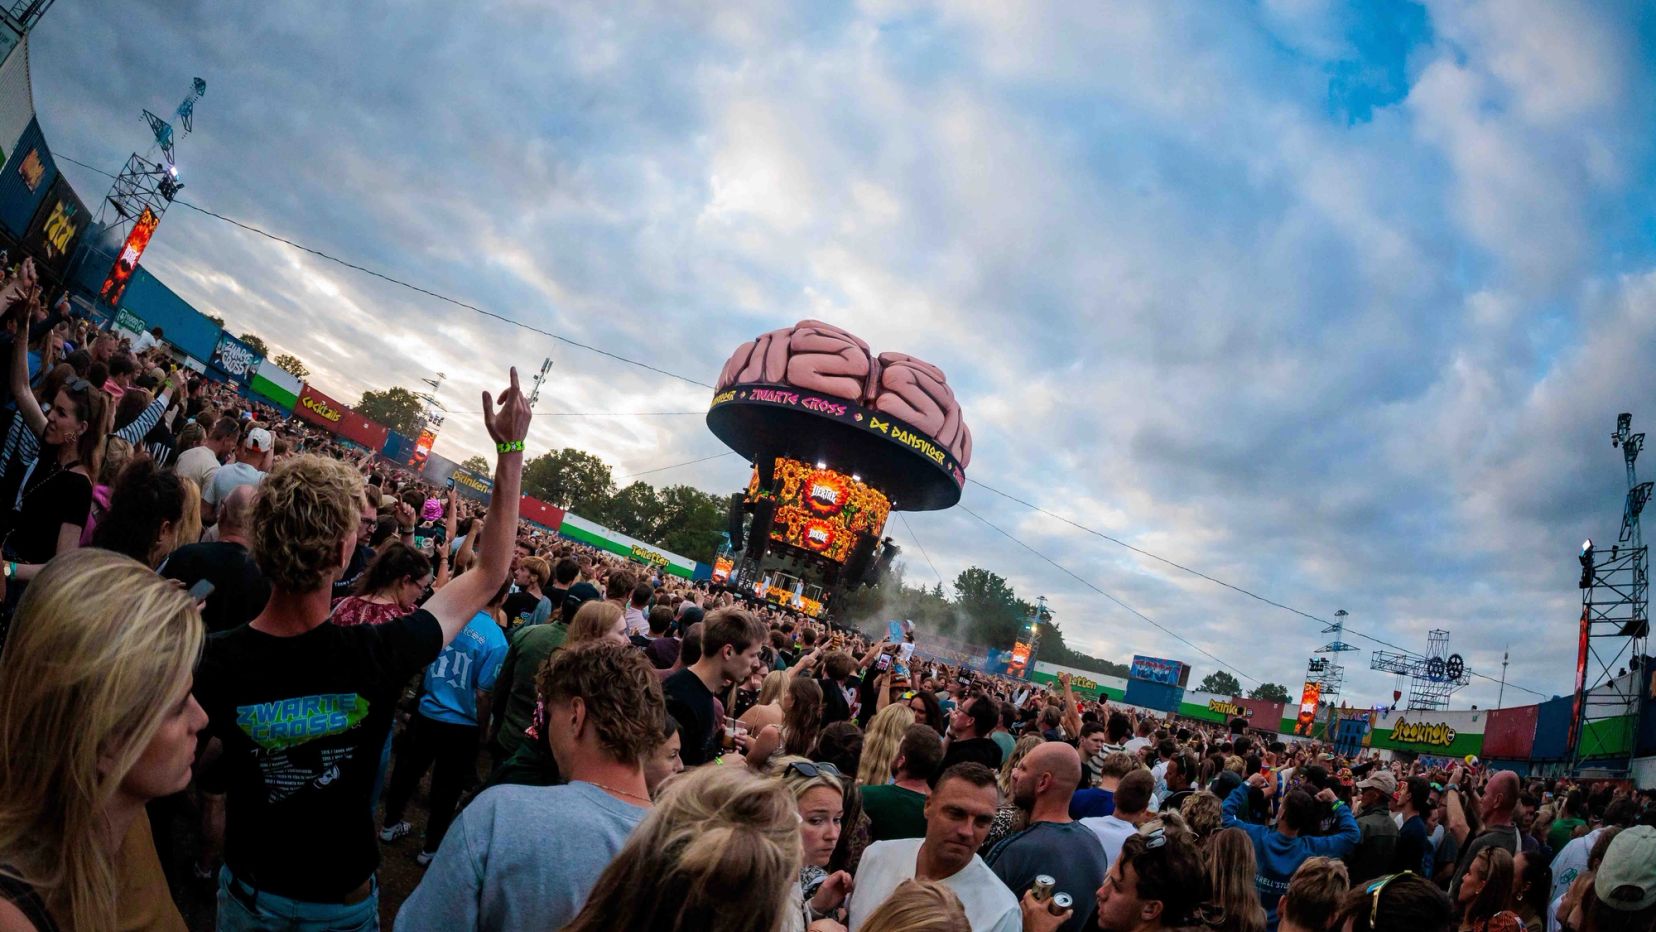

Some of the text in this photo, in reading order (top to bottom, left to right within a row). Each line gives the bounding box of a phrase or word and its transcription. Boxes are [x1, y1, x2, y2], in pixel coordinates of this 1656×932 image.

[749, 388, 847, 416] ZWARTE CROSS
[870, 416, 946, 465] DE DANSVLOER
[1057, 671, 1097, 690] Tletten
[236, 692, 358, 727] ZWARTE
[251, 711, 349, 742] CROSS
